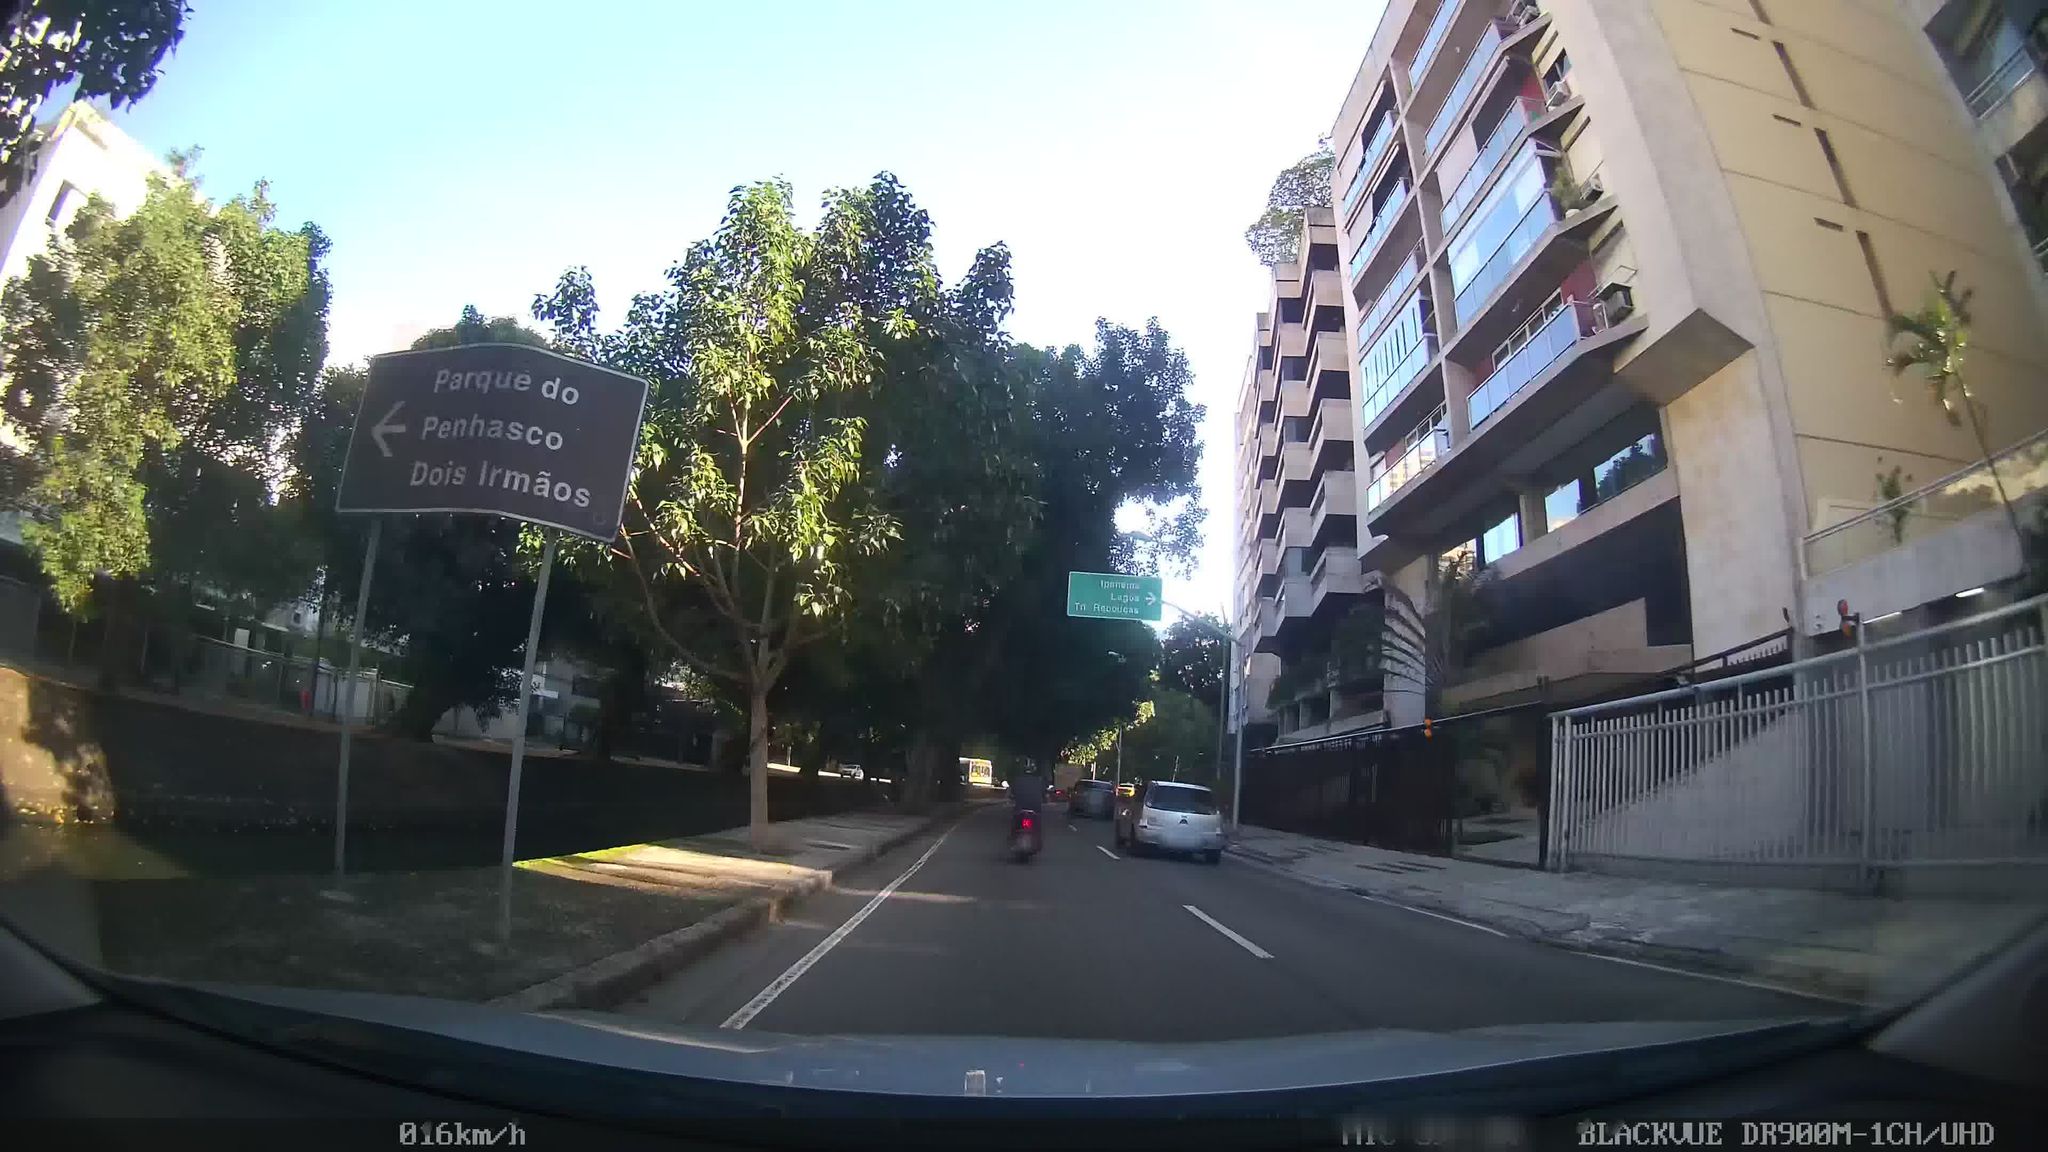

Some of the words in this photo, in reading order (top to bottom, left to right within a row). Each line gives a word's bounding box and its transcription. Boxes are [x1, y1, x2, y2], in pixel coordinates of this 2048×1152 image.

[433, 368, 532, 394] Parque
[541, 377, 579, 405] do
[422, 413, 563, 450] Penhasco
[410, 460, 467, 488] Dois
[479, 460, 591, 508] Irmãos
